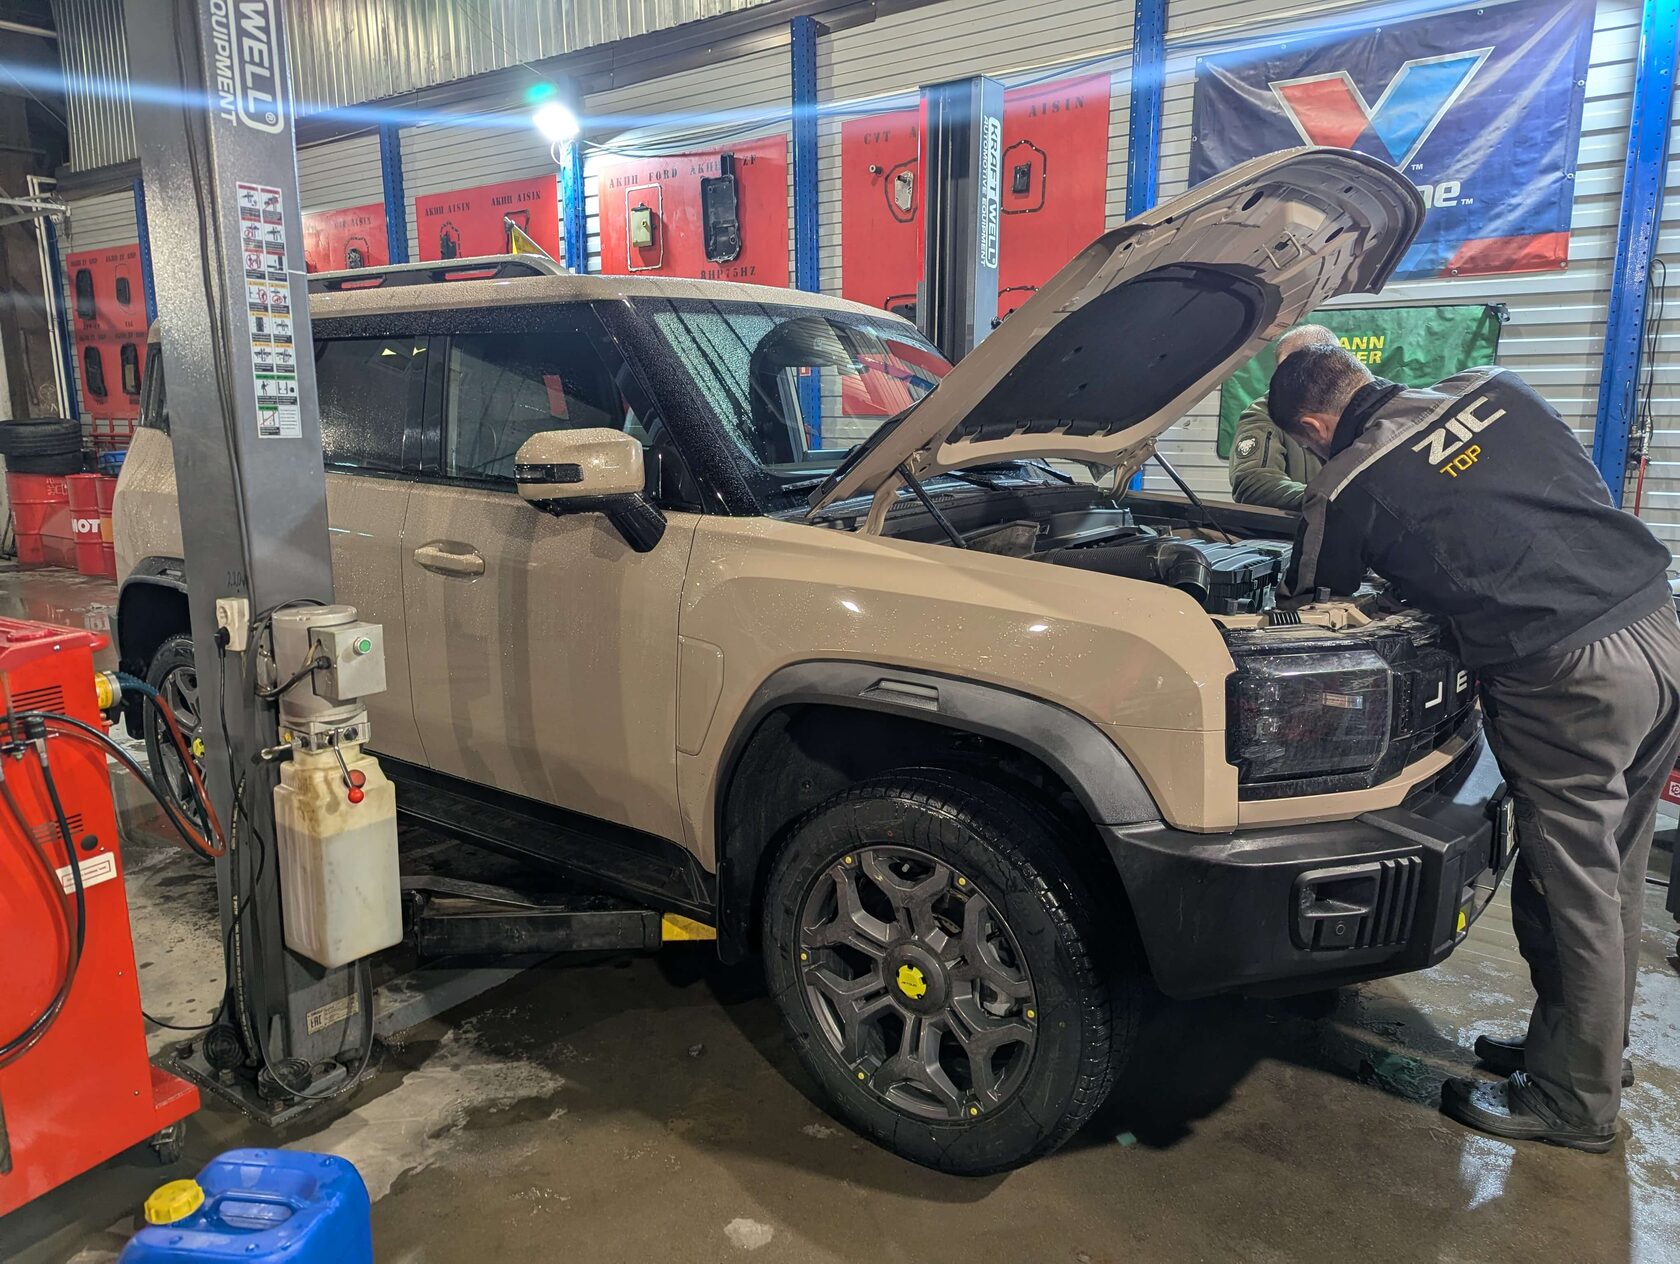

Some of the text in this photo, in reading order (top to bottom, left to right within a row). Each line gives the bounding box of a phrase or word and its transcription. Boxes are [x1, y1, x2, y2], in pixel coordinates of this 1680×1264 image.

[210, 0, 237, 126] QUIPMENT
[1029, 95, 1084, 118] AISIN
[648, 167, 678, 182] FORD
[980, 115, 990, 267] AUTOMOTIVE EQUIPMENT
[1339, 335, 1386, 350] ANN
[1354, 350, 1383, 365] ER
[1410, 395, 1508, 466] ZIC
[1439, 444, 1482, 478] TOP
